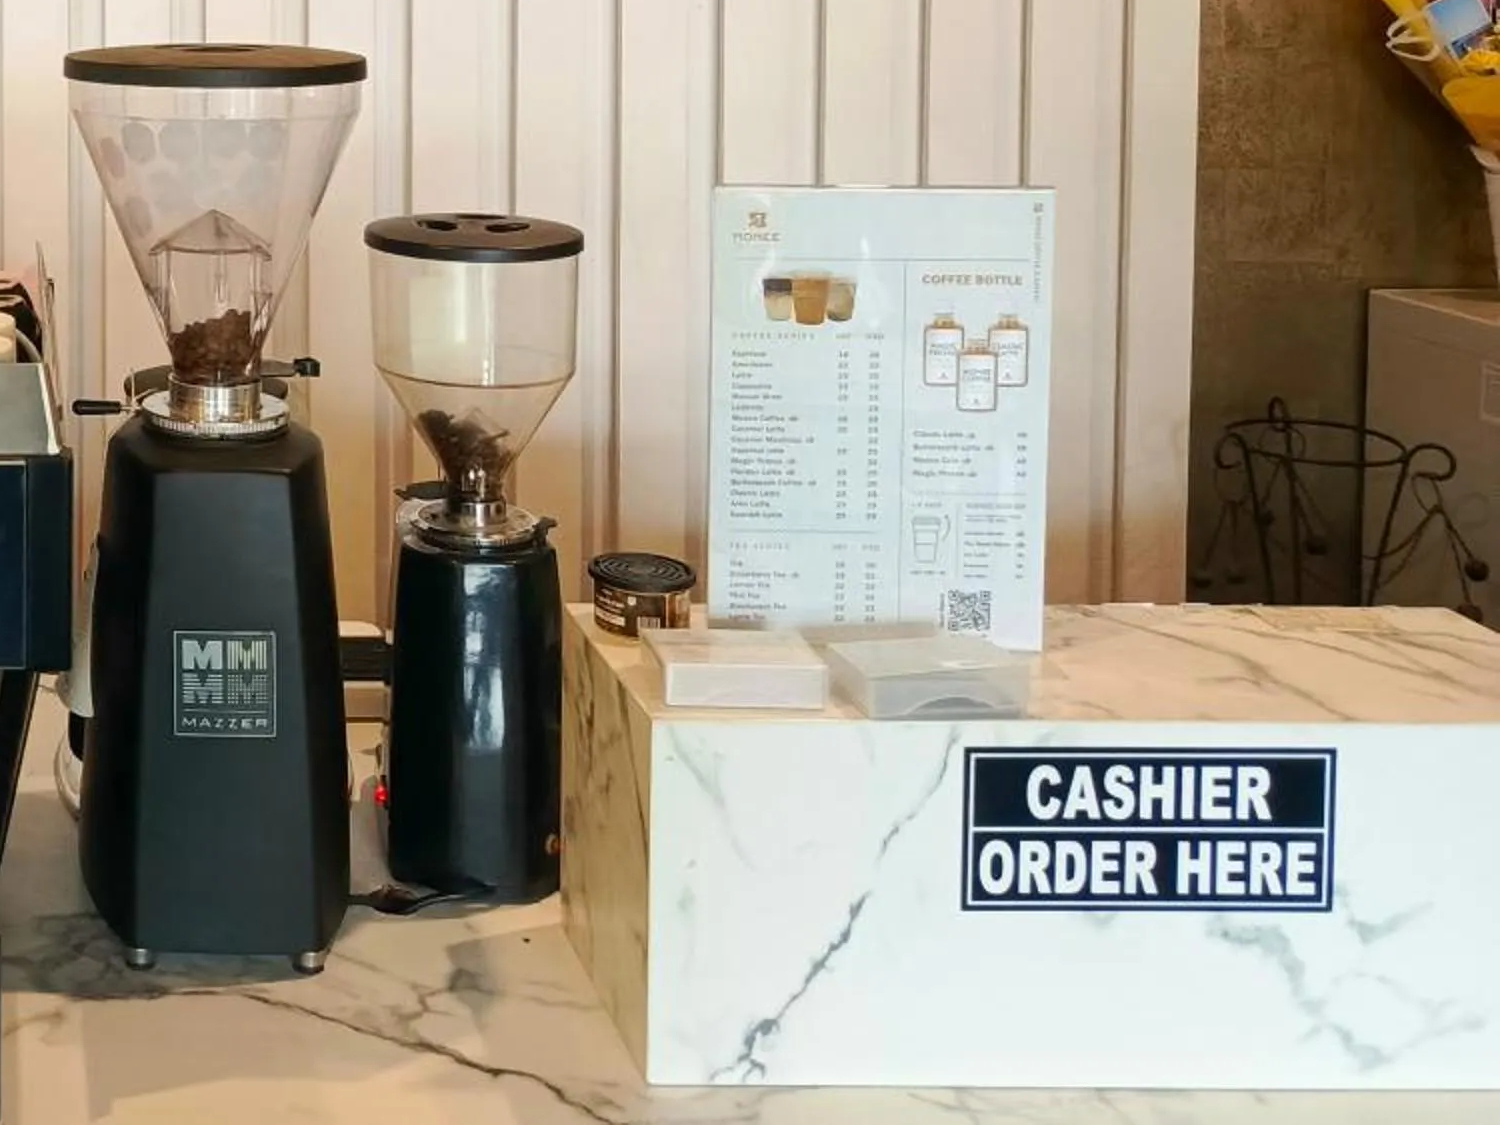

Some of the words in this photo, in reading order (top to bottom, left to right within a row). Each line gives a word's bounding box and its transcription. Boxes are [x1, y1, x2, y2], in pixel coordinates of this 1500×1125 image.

[921, 273, 972, 285] COFFEE
[975, 274, 1023, 286] BOTTLE
[181, 716, 269, 730] MAZZER
[1026, 764, 1273, 821] CASHIER
[978, 839, 1159, 896] ORDER
[1176, 840, 1317, 896] HERE
